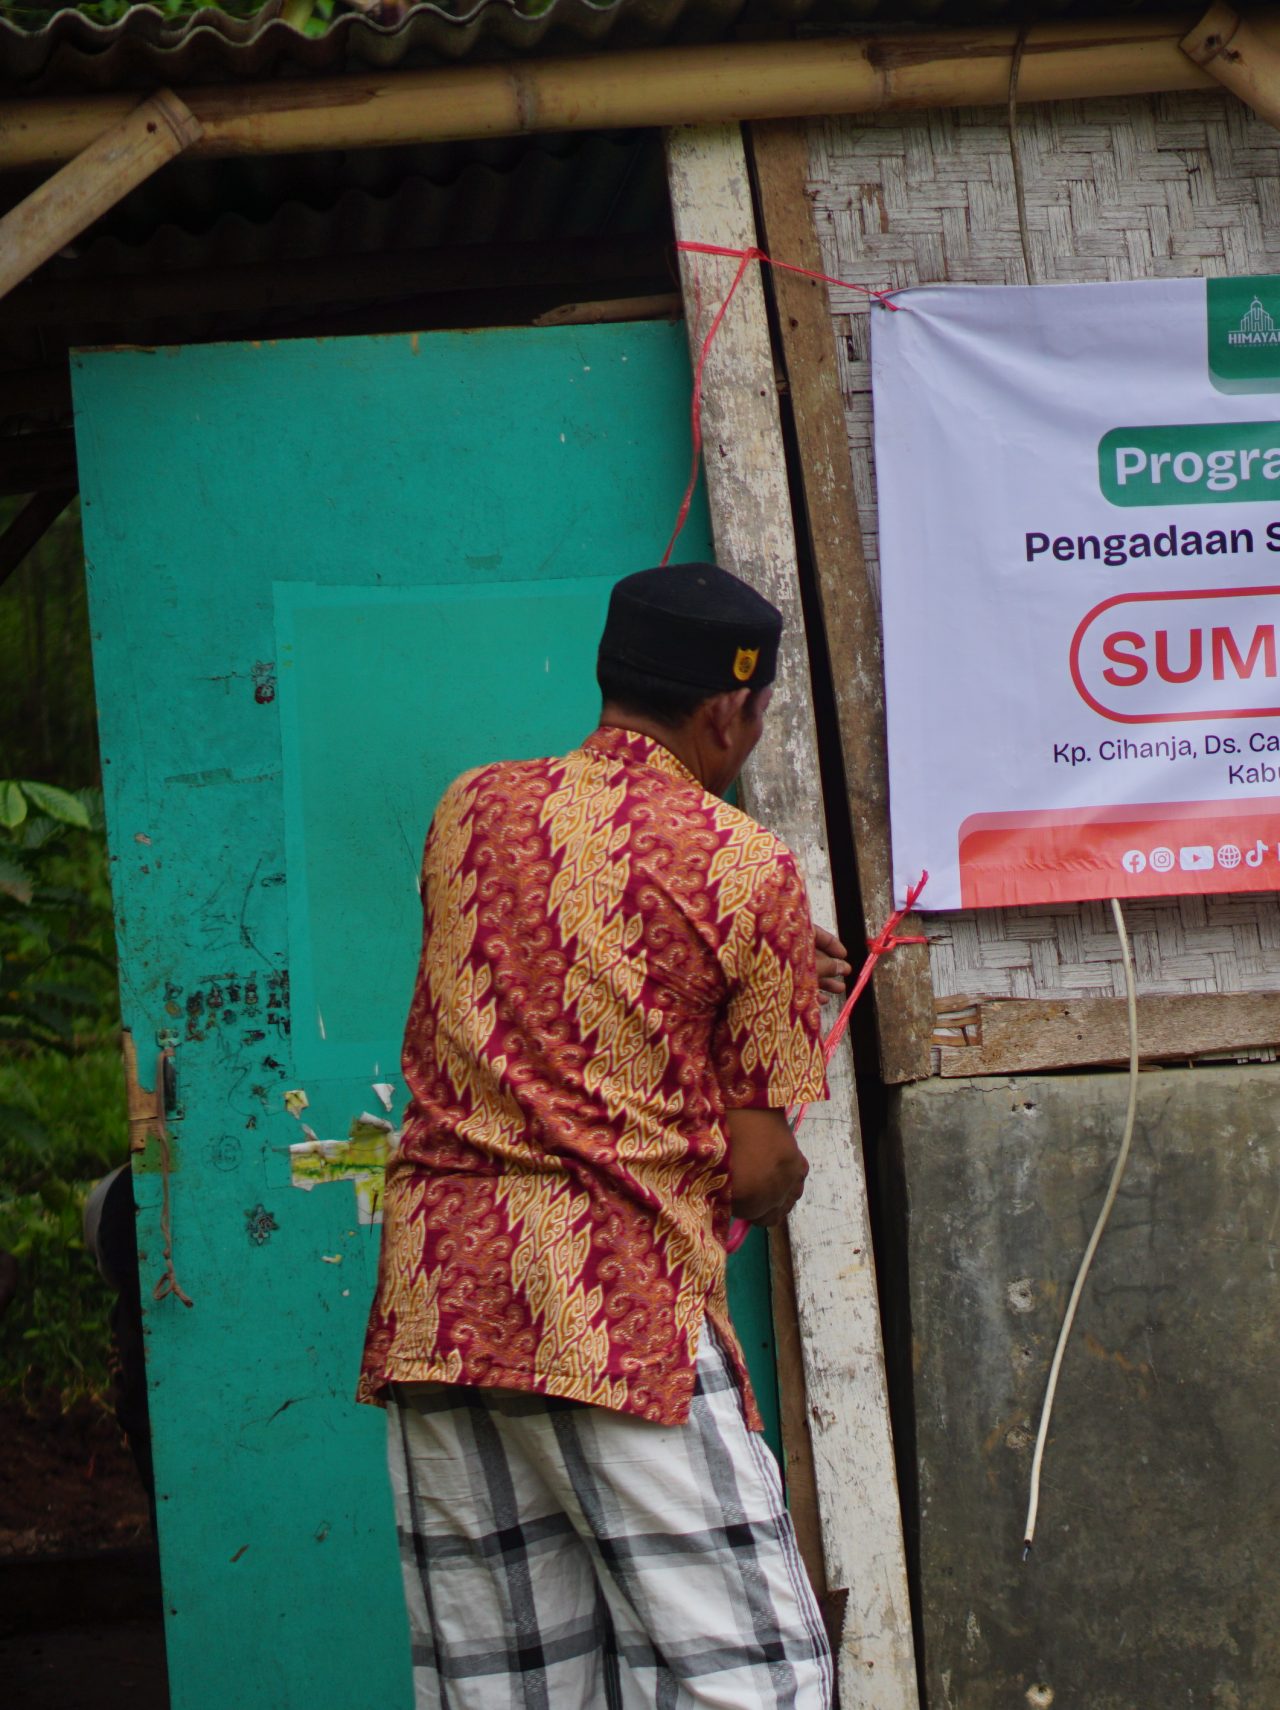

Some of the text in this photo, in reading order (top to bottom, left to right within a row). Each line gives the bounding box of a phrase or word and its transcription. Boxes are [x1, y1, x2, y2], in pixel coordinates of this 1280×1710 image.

[1025, 524, 1254, 567] Pengadaan
[1053, 743, 1092, 766] Kp.
[1098, 736, 1198, 762] Cihanja,
[1204, 734, 1242, 755] Ds.
